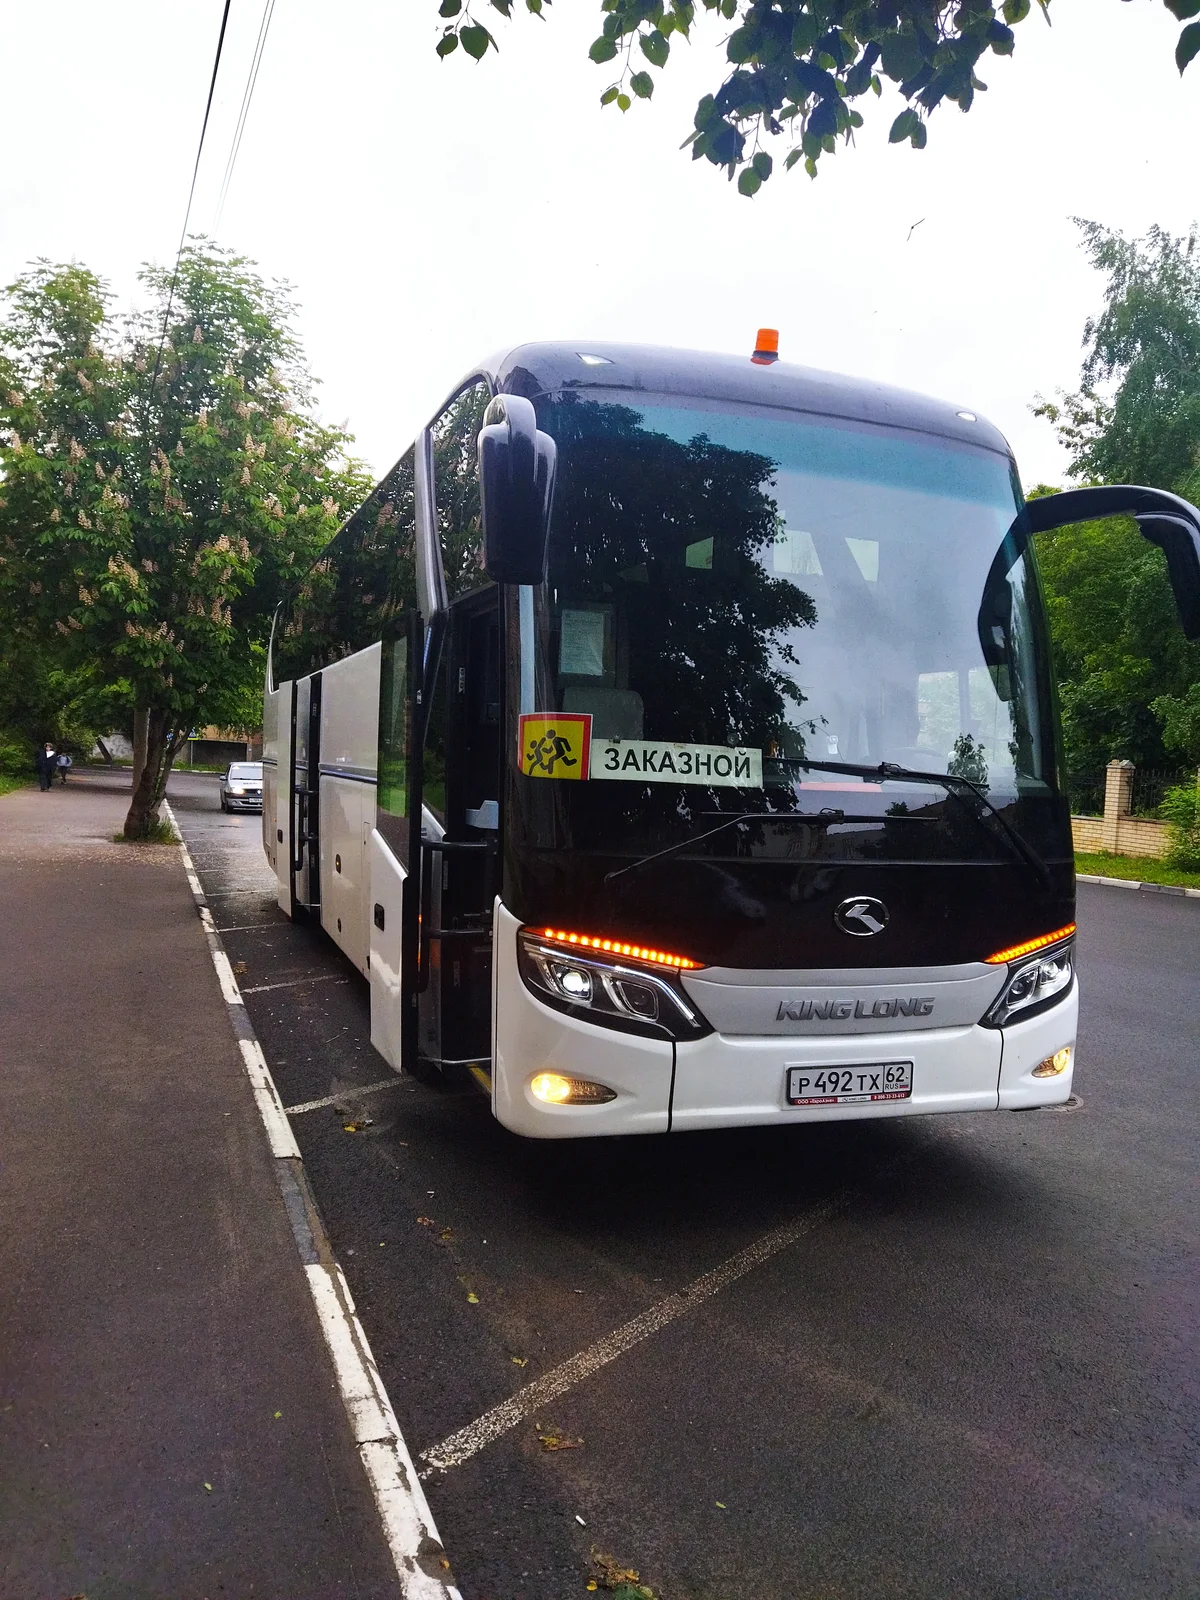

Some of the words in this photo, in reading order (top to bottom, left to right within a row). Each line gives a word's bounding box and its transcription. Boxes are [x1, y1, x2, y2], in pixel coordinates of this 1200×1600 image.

[604, 748, 751, 779] ЗАКАЗНОЙ
[776, 1000, 854, 1021] KING
[854, 997, 936, 1019] LONG
[885, 1066, 905, 1083] 62
[884, 1082, 899, 1090] RUS
